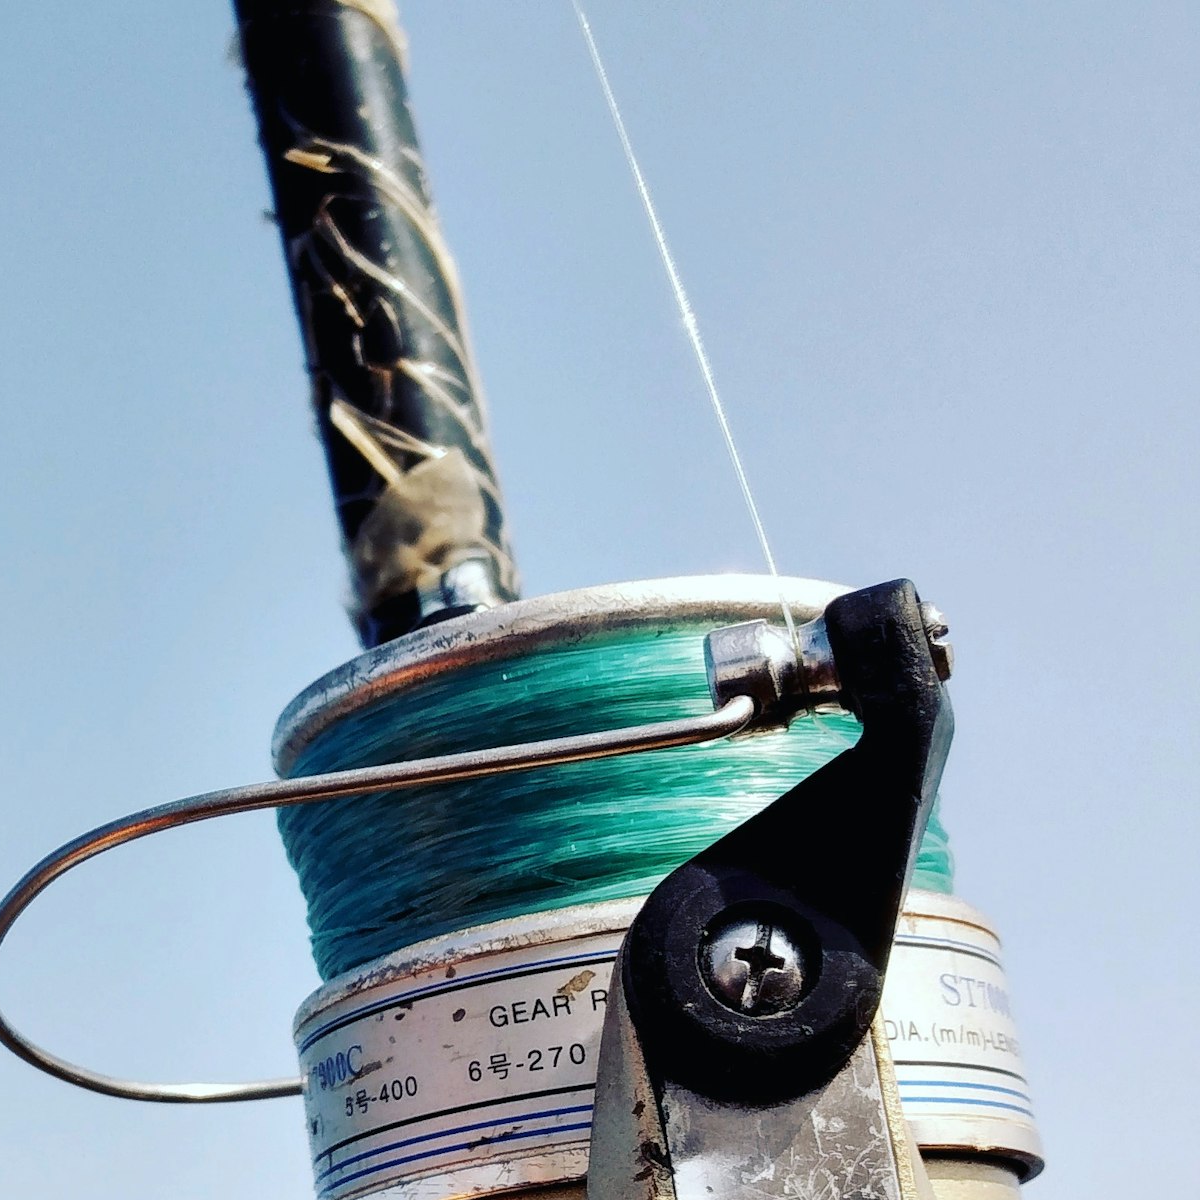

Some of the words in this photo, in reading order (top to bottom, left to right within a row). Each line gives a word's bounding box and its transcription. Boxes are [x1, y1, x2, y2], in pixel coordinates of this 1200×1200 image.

[489, 994, 571, 1027] GEAR
[468, 1043, 586, 1081] 6号-270
[345, 1076, 417, 1117] 5号-400
